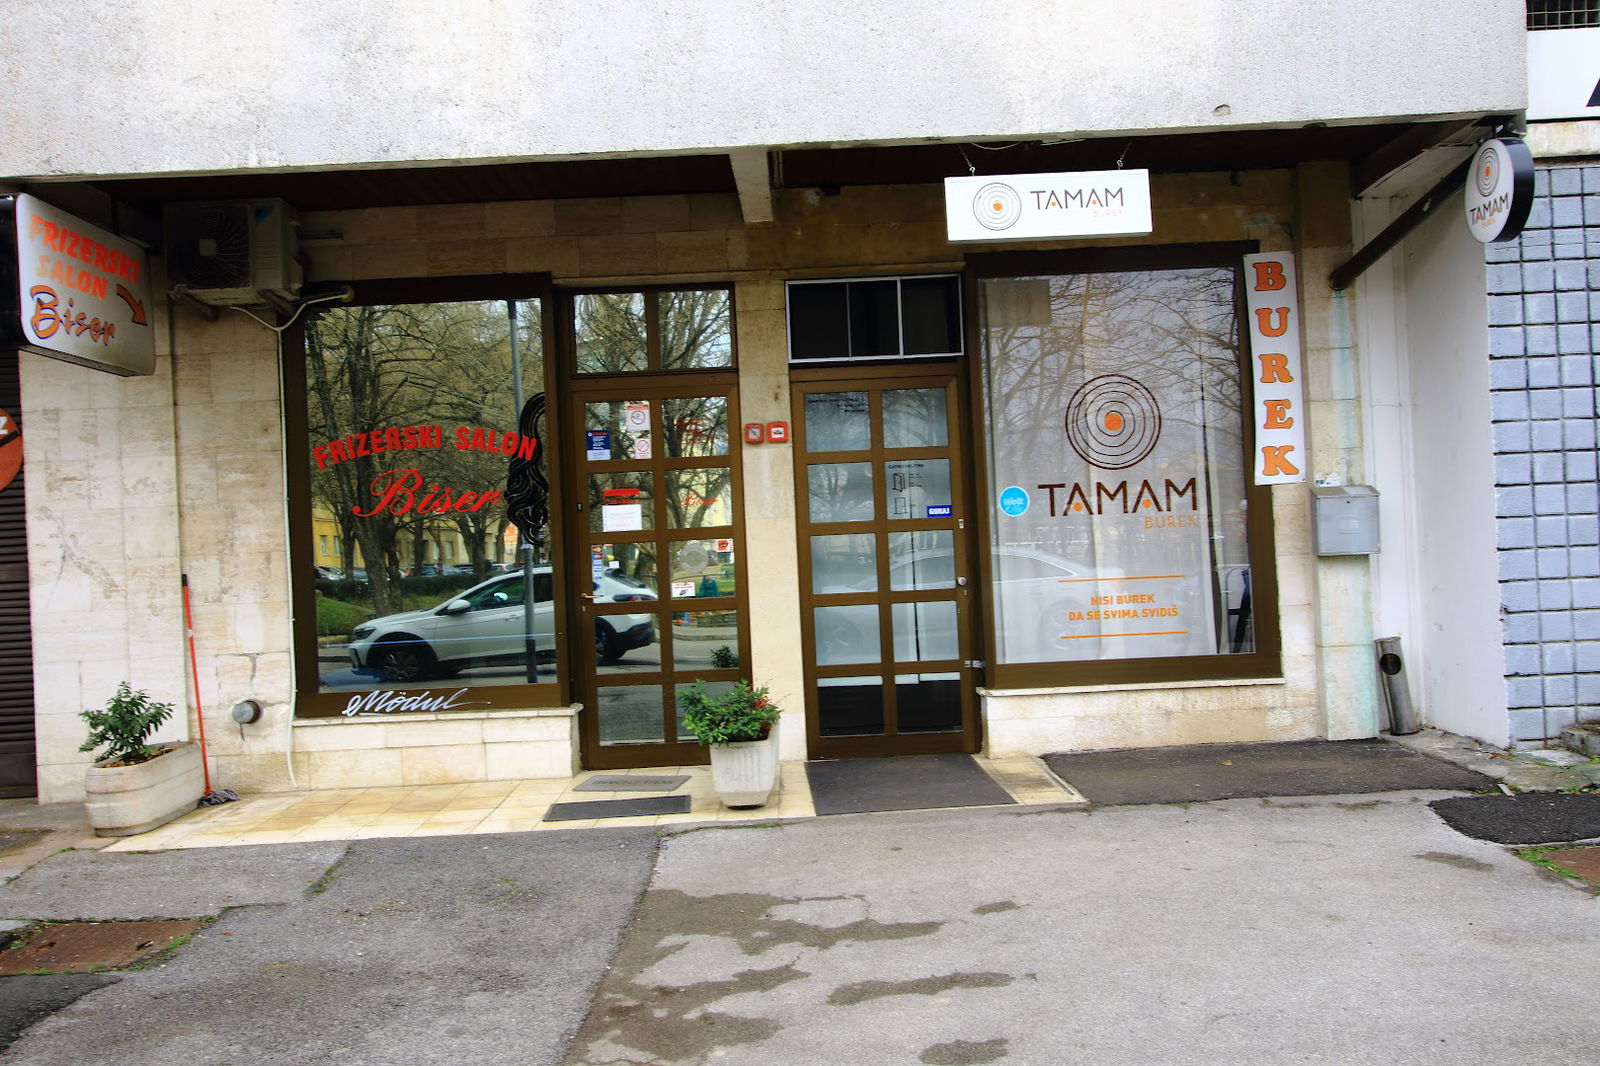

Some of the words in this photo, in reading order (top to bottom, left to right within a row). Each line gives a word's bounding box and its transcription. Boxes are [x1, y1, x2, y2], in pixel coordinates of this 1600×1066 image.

[1030, 187, 1124, 210] TAMAM
[1469, 192, 1509, 225] TAMAM
[30, 214, 140, 282] FRIZERSKI
[36, 255, 108, 300] SALON
[30, 284, 117, 346] Biser
[1252, 261, 1299, 477] BUREK
[312, 425, 442, 470] FRIZERSKI
[455, 426, 537, 461] SALON
[352, 469, 502, 518] Biser
[1038, 477, 1198, 516] TAMAM
[1144, 514, 1198, 530] BUREK
[1068, 611, 1083, 621] DA
[1086, 611, 1101, 621] SE
[1104, 609, 1139, 620] SVIMA
[1141, 604, 1179, 618] SVIDIŠ
[1090, 596, 1113, 606] NISI
[1116, 593, 1156, 605] BUREK
